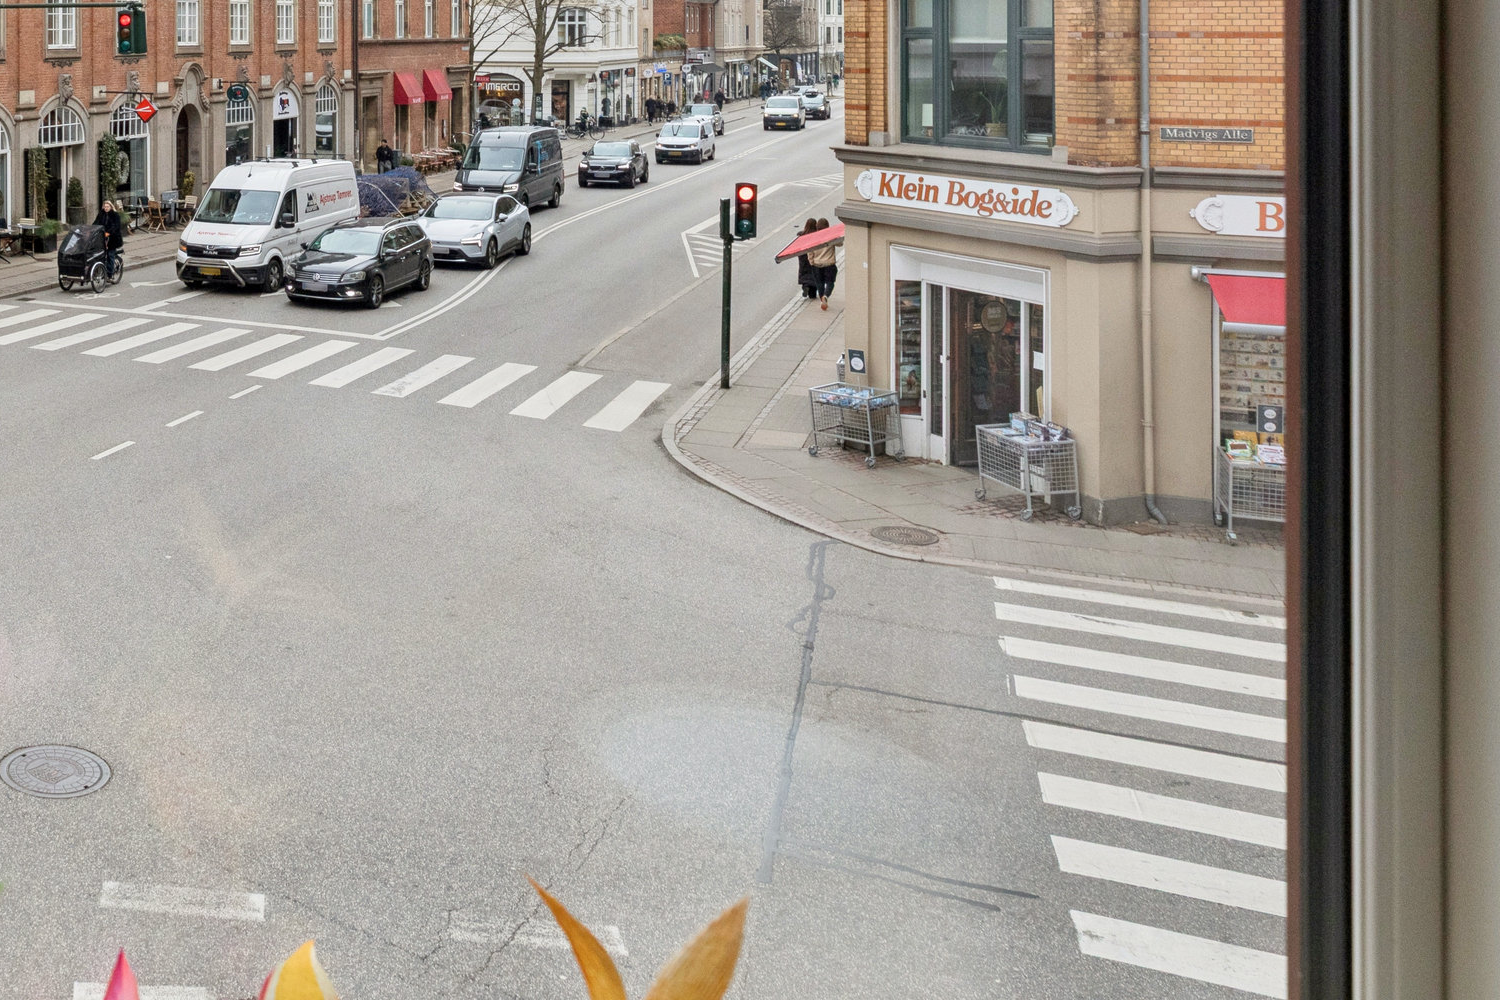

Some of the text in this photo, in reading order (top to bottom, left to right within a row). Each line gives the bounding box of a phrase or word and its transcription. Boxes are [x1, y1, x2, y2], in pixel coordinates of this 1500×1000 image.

[664, 73, 671, 81] P
[485, 82, 520, 91] IMERCO
[1165, 128, 1218, 140] Madvigs
[878, 172, 1052, 218] Klein Bog&ide
